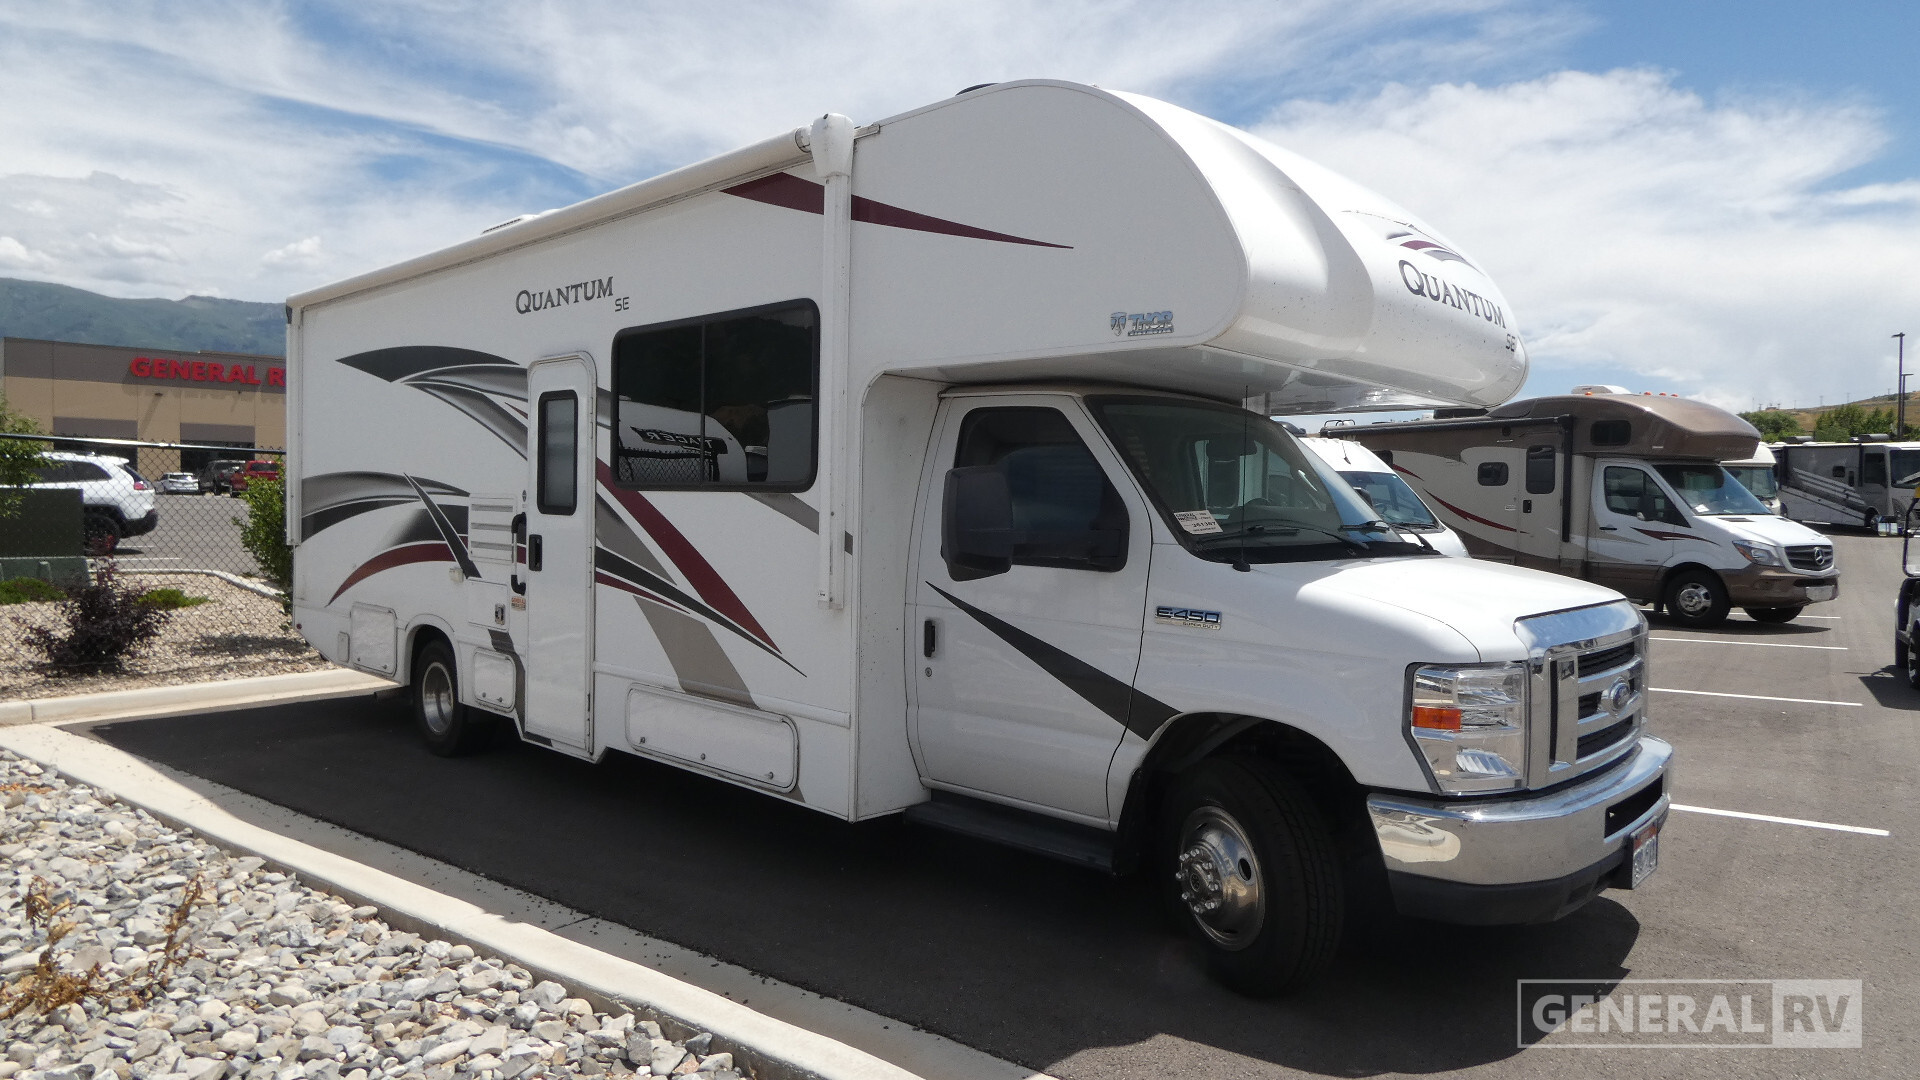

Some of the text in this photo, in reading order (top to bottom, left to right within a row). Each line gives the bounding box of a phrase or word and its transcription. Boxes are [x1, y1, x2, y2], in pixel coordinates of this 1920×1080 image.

[515, 276, 614, 314] QUANTUM
[615, 296, 630, 312] SE
[1399, 260, 1507, 329] QUANTUM
[1128, 311, 1174, 330] THOR
[1505, 333, 1516, 352] SE
[130, 357, 287, 387] GENERAL R
